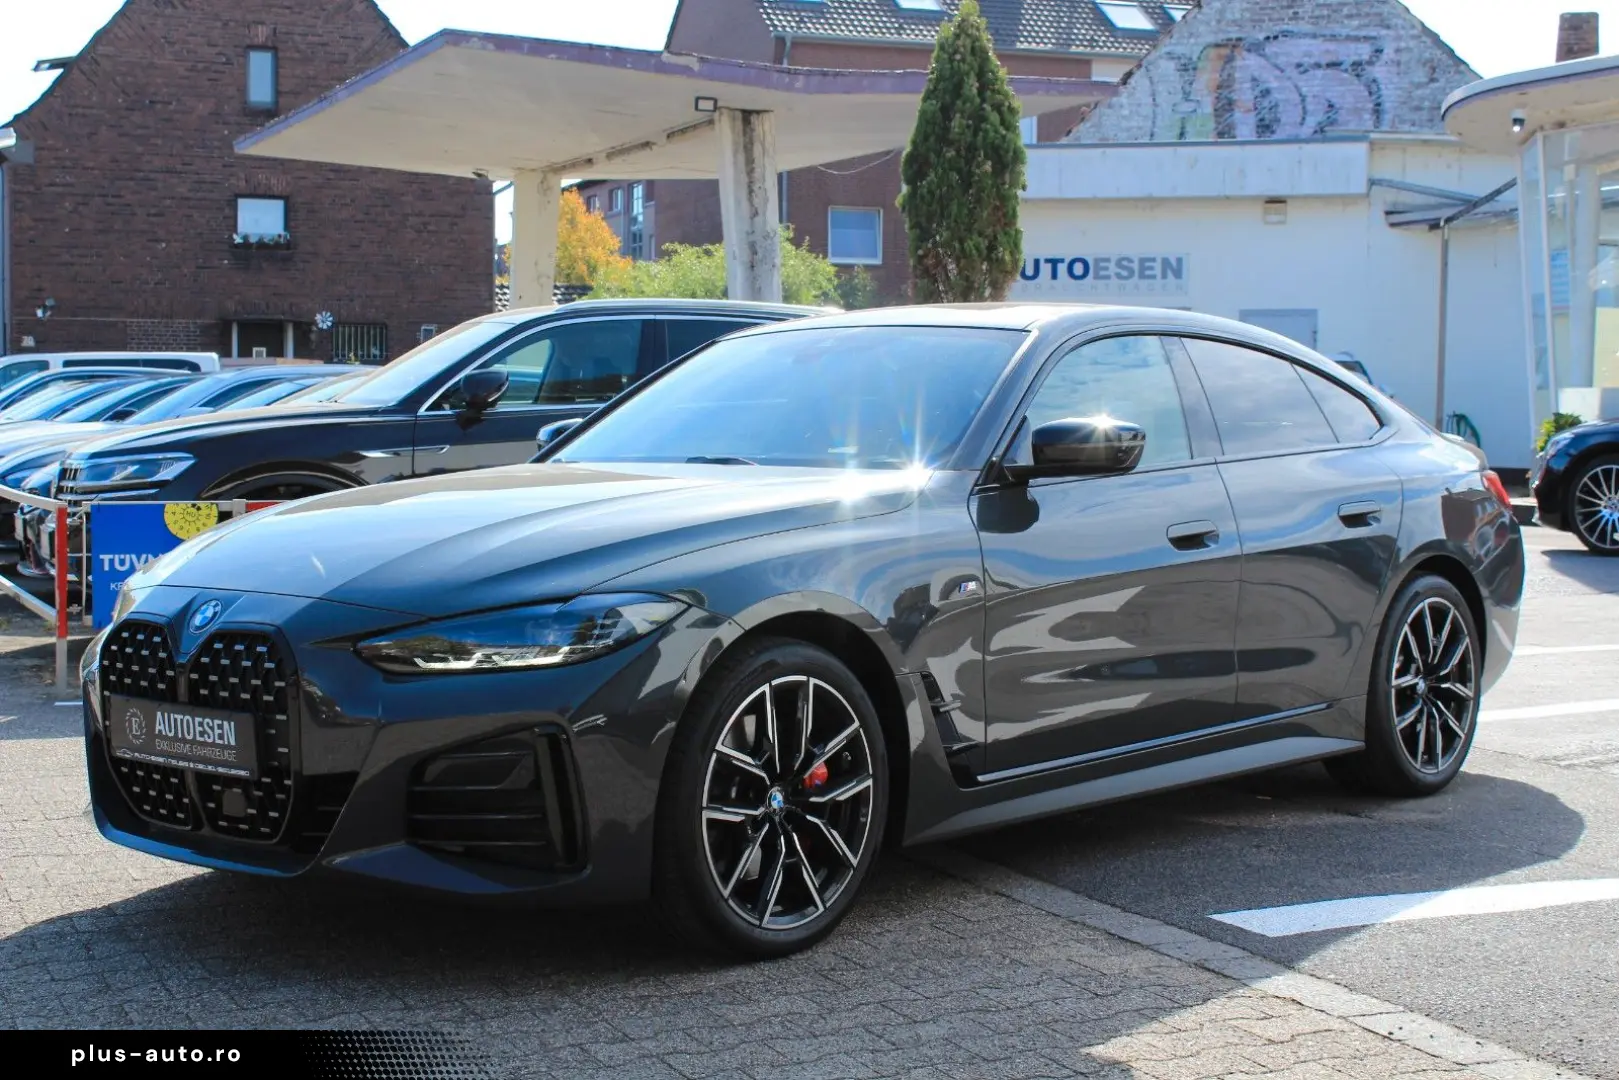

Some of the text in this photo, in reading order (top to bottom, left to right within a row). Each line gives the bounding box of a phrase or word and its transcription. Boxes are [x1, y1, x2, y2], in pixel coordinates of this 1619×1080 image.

[1019, 256, 1183, 281] UTOESEN
[1019, 282, 1183, 292] BRAUCHTWAGEN
[110, 582, 126, 591] KF
[155, 711, 237, 746] AUTOESEN
[155, 738, 238, 762] EXKLUSIVE FAHRZEUGE
